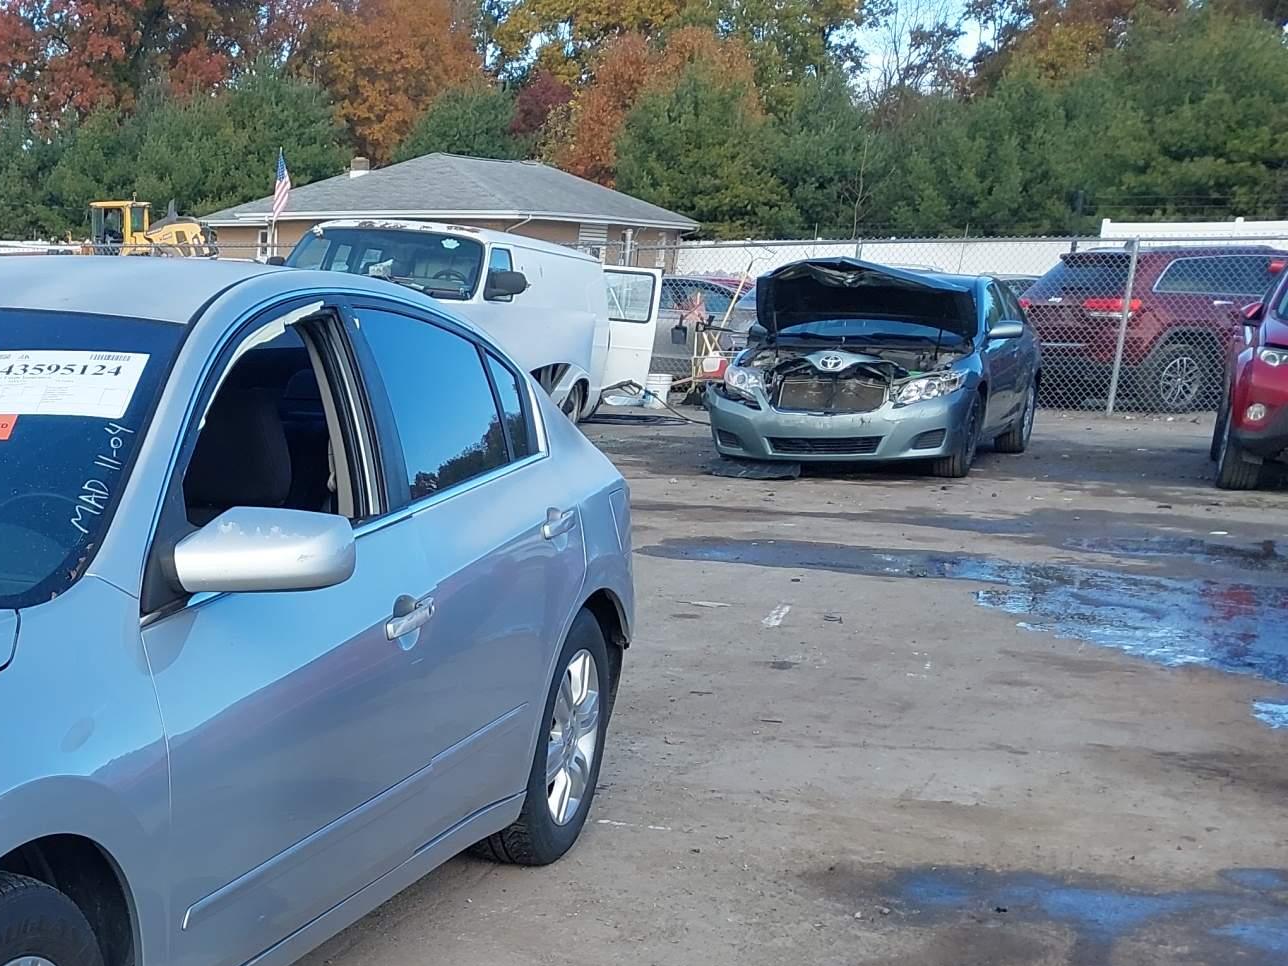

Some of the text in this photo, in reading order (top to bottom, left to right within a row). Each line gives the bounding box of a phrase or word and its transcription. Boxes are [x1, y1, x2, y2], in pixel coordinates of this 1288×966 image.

[0, 363, 123, 376] 43595124
[71, 422, 135, 534] MAD 11-04
